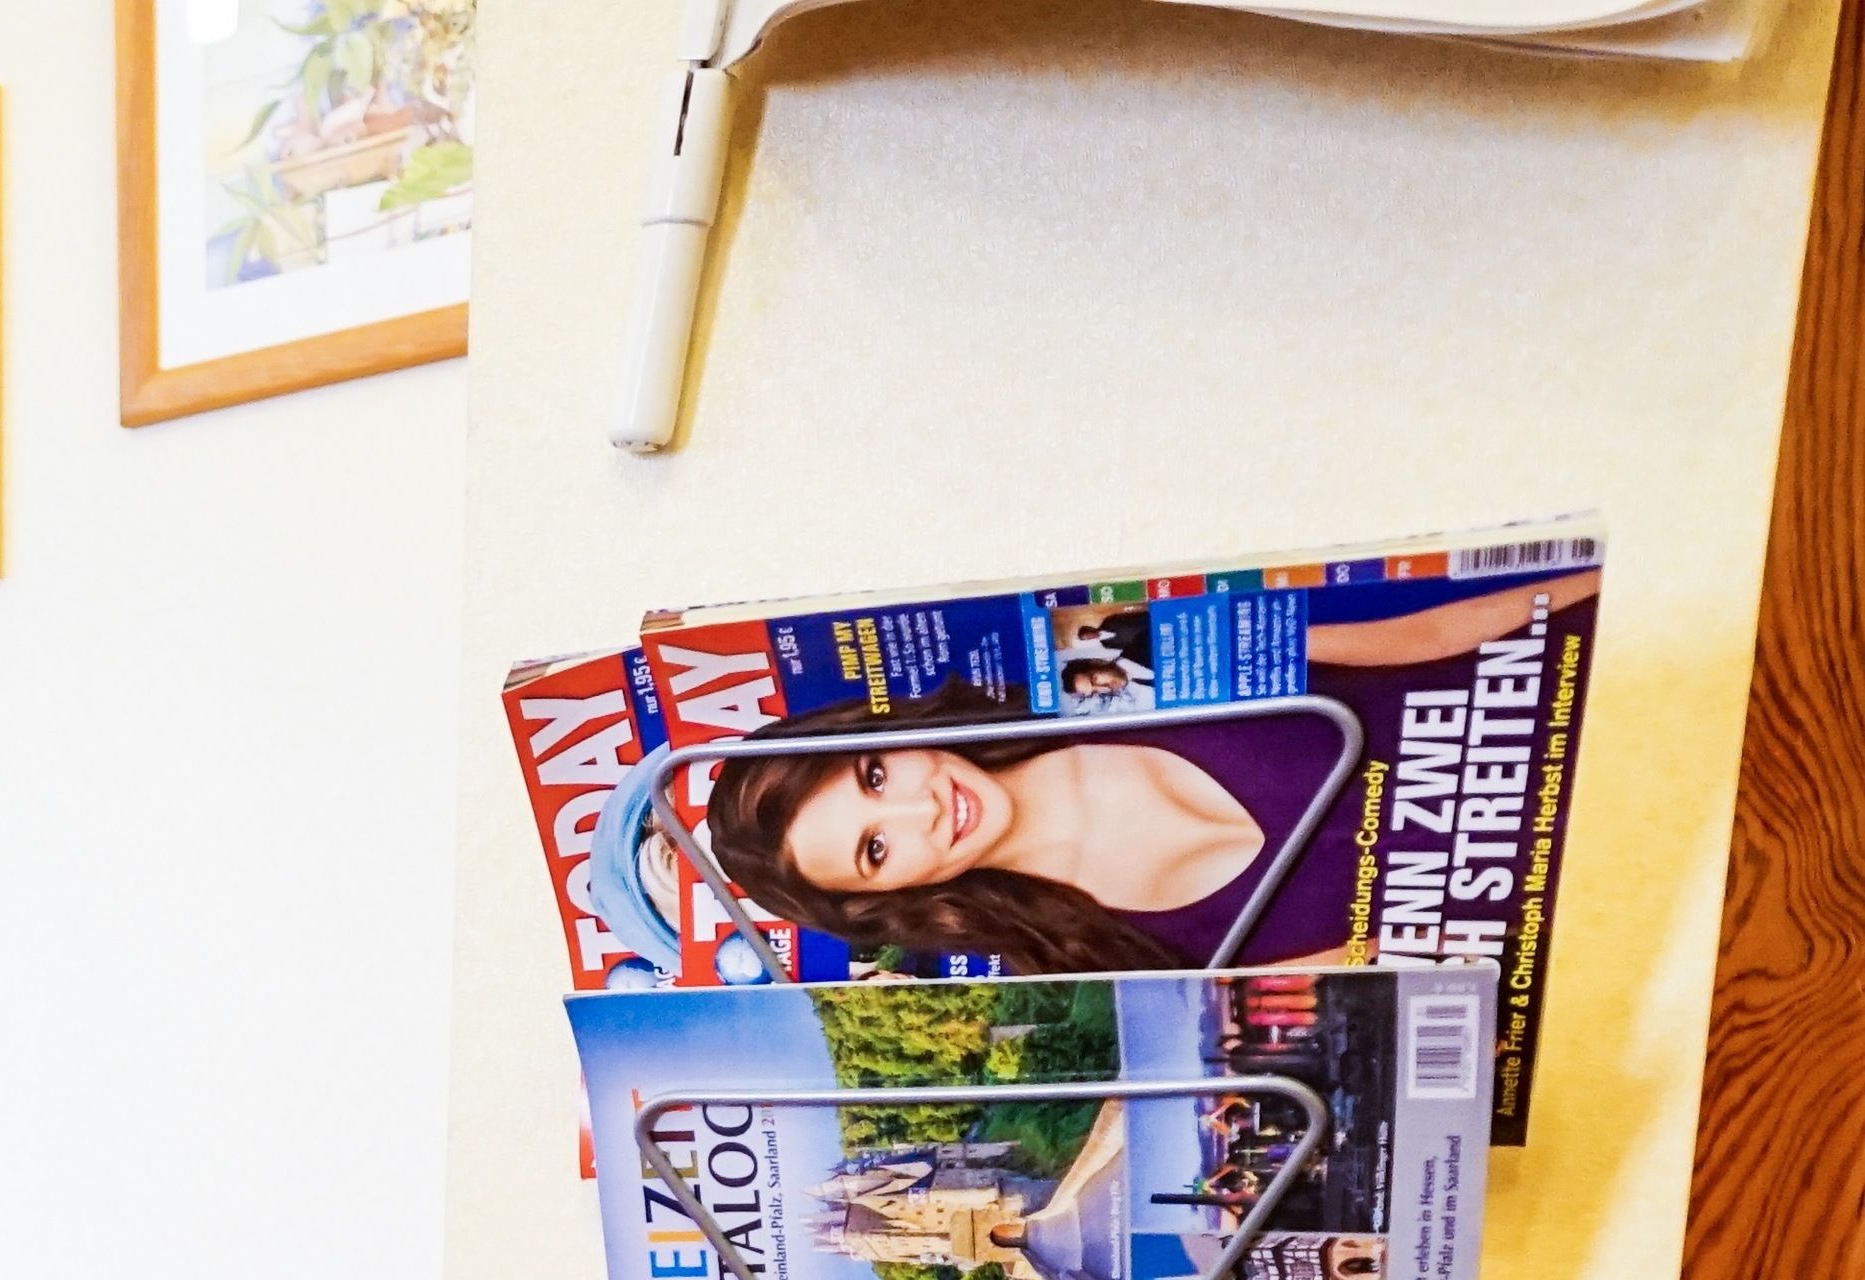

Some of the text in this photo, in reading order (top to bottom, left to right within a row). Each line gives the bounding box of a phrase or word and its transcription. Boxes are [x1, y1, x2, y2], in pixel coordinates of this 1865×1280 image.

[833, 621, 862, 679] PIMP MY
[856, 618, 891, 714] STREITWAGEN
[646, 696, 659, 714] nur
[1449, 593, 1550, 901] STREITEN...
[657, 644, 786, 942] TAY
[1378, 689, 1469, 967] ENN ZWEI
[1347, 760, 1390, 966] Scheidungs-Comedy
[1496, 635, 1582, 1116] Annette Frier & Christoph Maria Herbst im Interview
[767, 928, 792, 971] AGE
[950, 955, 968, 977] SS
[762, 1131, 780, 1188] Saarland
[1444, 1135, 1461, 1191] Saarland
[1419, 1209, 1432, 1222] in
[1440, 1216, 1456, 1240] und
[1444, 1195, 1457, 1211] im
[1415, 1225, 1432, 1273] erleben
